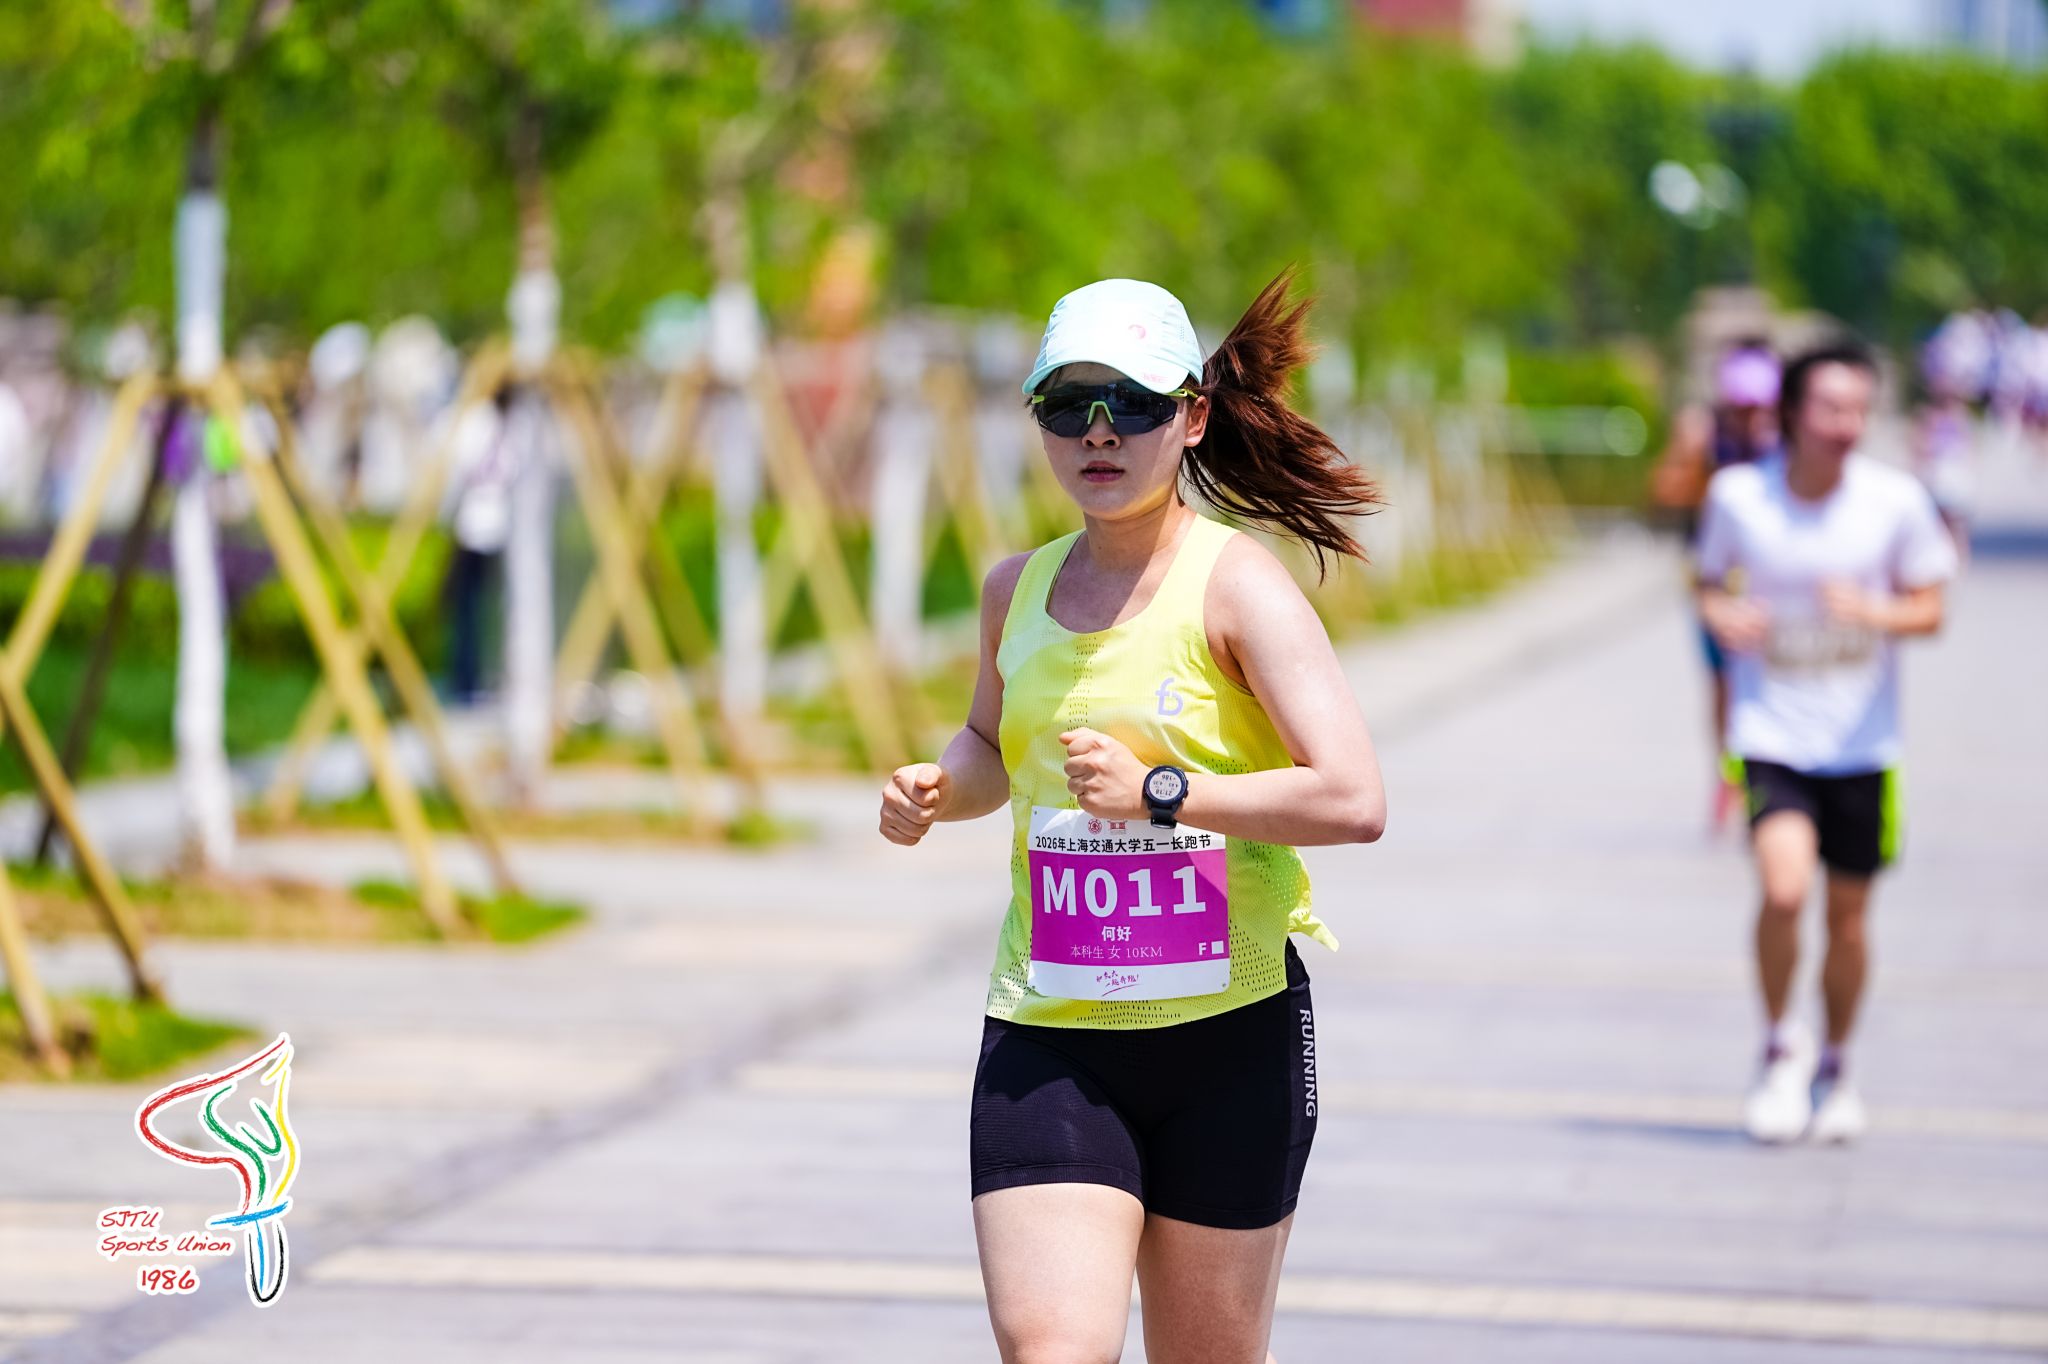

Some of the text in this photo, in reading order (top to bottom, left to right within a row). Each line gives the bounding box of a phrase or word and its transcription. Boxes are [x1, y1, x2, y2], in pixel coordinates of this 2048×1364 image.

[1035, 835, 1211, 853] 2026年上海交通大学五一长跑节
[1042, 865, 1206, 918] M011
[1101, 926, 1132, 942] 何好
[1070, 945, 1163, 959] 本科生 女 10KM
[1198, 942, 1207, 955] F
[1300, 1009, 1316, 1118] RUNNING
